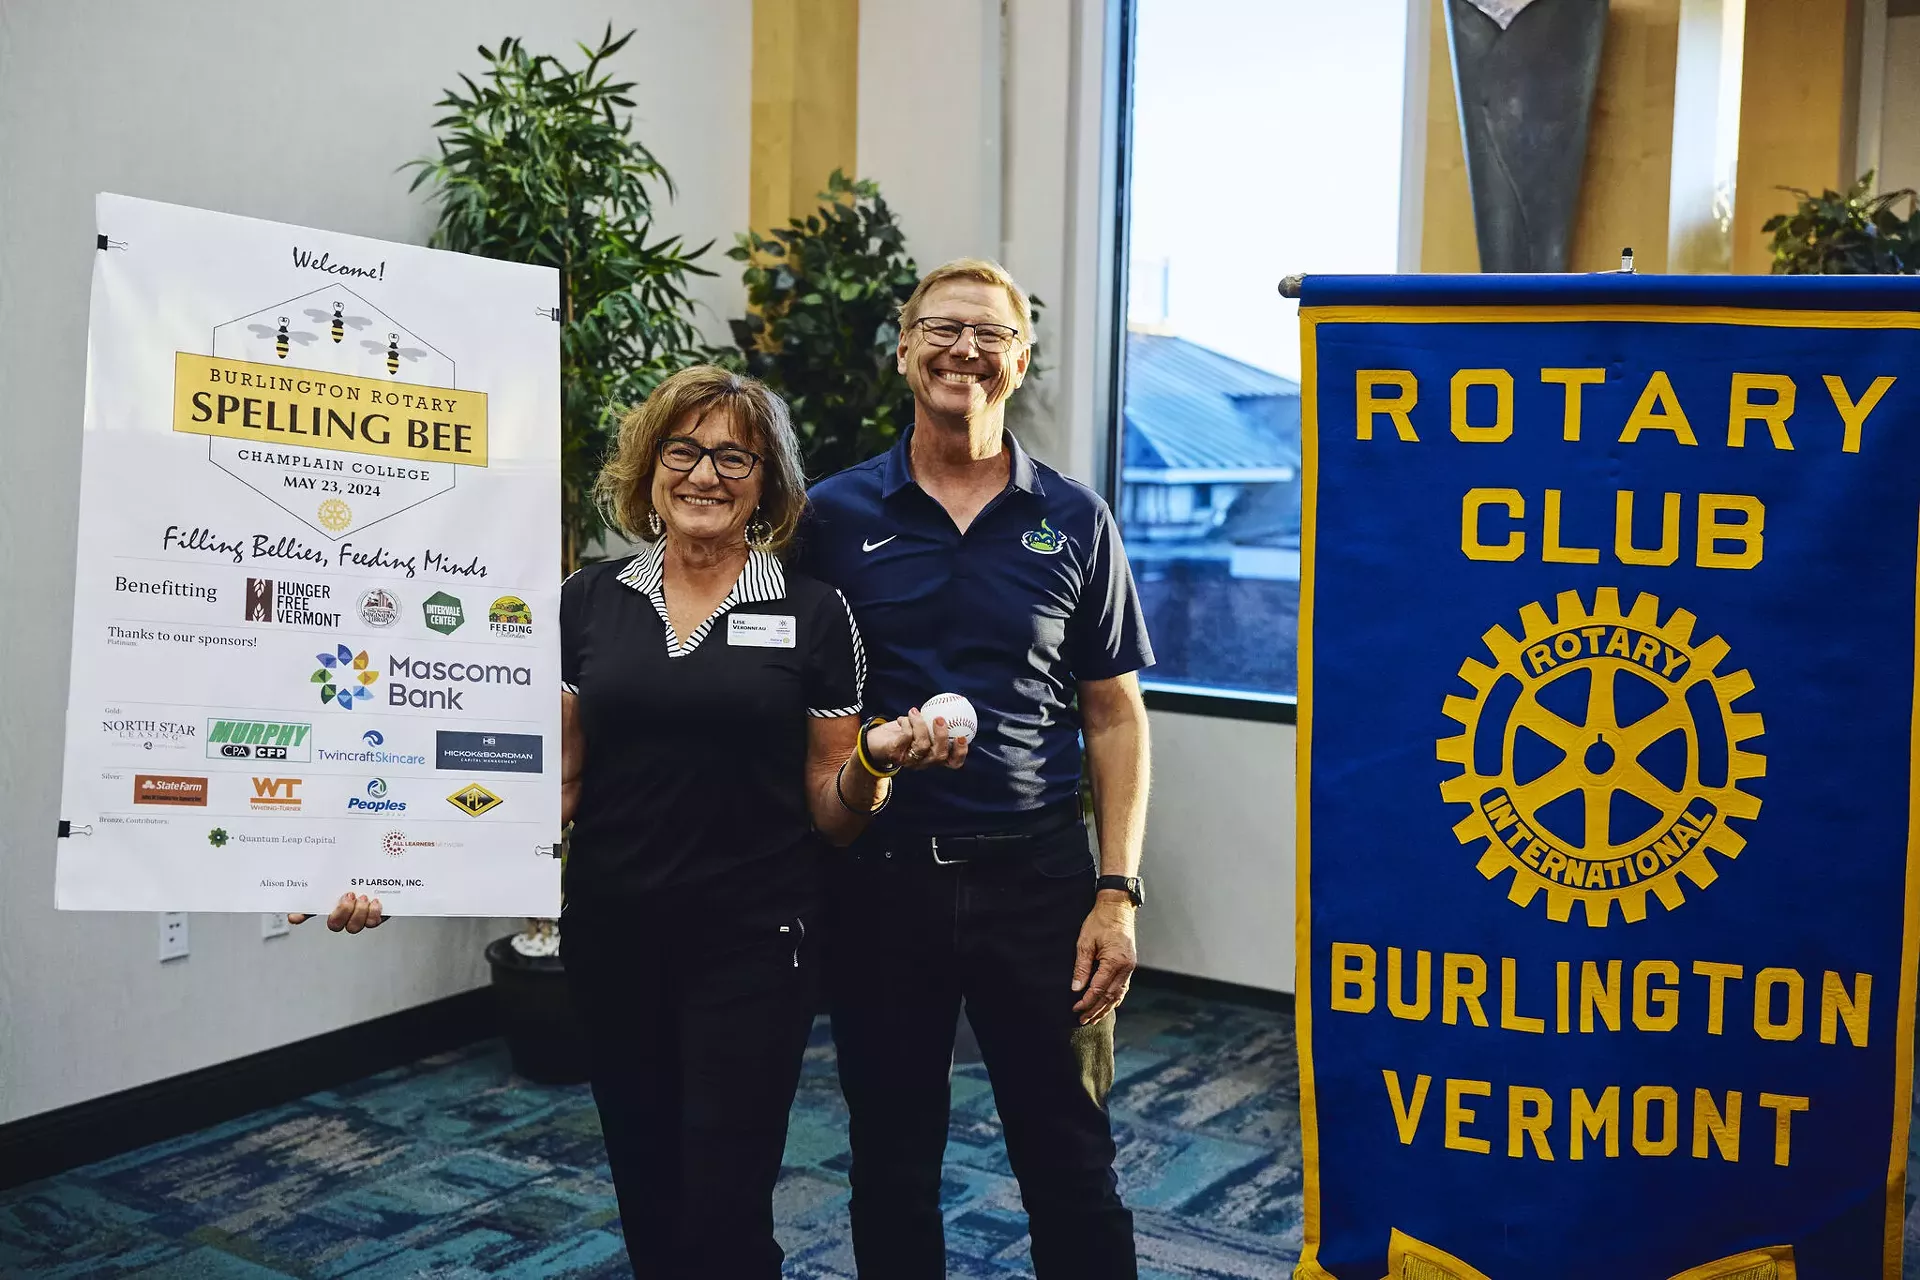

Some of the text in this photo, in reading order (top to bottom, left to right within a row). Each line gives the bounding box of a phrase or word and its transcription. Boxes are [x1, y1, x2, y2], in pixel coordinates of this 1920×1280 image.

[292, 246, 386, 281] Welcome!
[210, 368, 457, 413] BURLINGTON ROTARY
[1355, 368, 1897, 454] ROTARY
[191, 391, 472, 454] SPELLING BEE
[238, 449, 430, 482] CHAMPLAIN COLLEGE
[283, 475, 381, 498] MAY 23, 2024
[1461, 488, 1765, 569] CLUB
[163, 526, 488, 579] Filling Bellies, Feeding Minds
[114, 576, 218, 603] Benefitting
[276, 580, 331, 599] HUNGER
[276, 595, 310, 612] FREE
[426, 603, 461, 617] INTERVALE
[276, 609, 342, 628] VERMONT
[430, 614, 457, 626] CENTER
[490, 623, 532, 635] FEEDING
[107, 626, 257, 648] Thanks to our sponsors!
[1526, 626, 1687, 677] ROTARY
[389, 653, 532, 687] Mascoma
[389, 683, 464, 711] Bank
[102, 720, 196, 737] NORTH STAR
[119, 731, 179, 741] LEASING
[208, 720, 311, 747] MURPHY
[223, 745, 286, 759] CPA CFP
[444, 749, 533, 760] HICKOK&BOARDMAN
[252, 777, 303, 798] WT
[347, 797, 407, 813] Peoples
[238, 834, 336, 847] Quantum Leap Capital
[1484, 794, 1713, 889] INTERNATIONAL
[259, 879, 309, 888] Alison Davis
[351, 878, 424, 887] S P LARSON, INC.
[1331, 942, 1873, 1048] BURLINGTON
[1382, 1069, 1810, 1167] VERMONT
